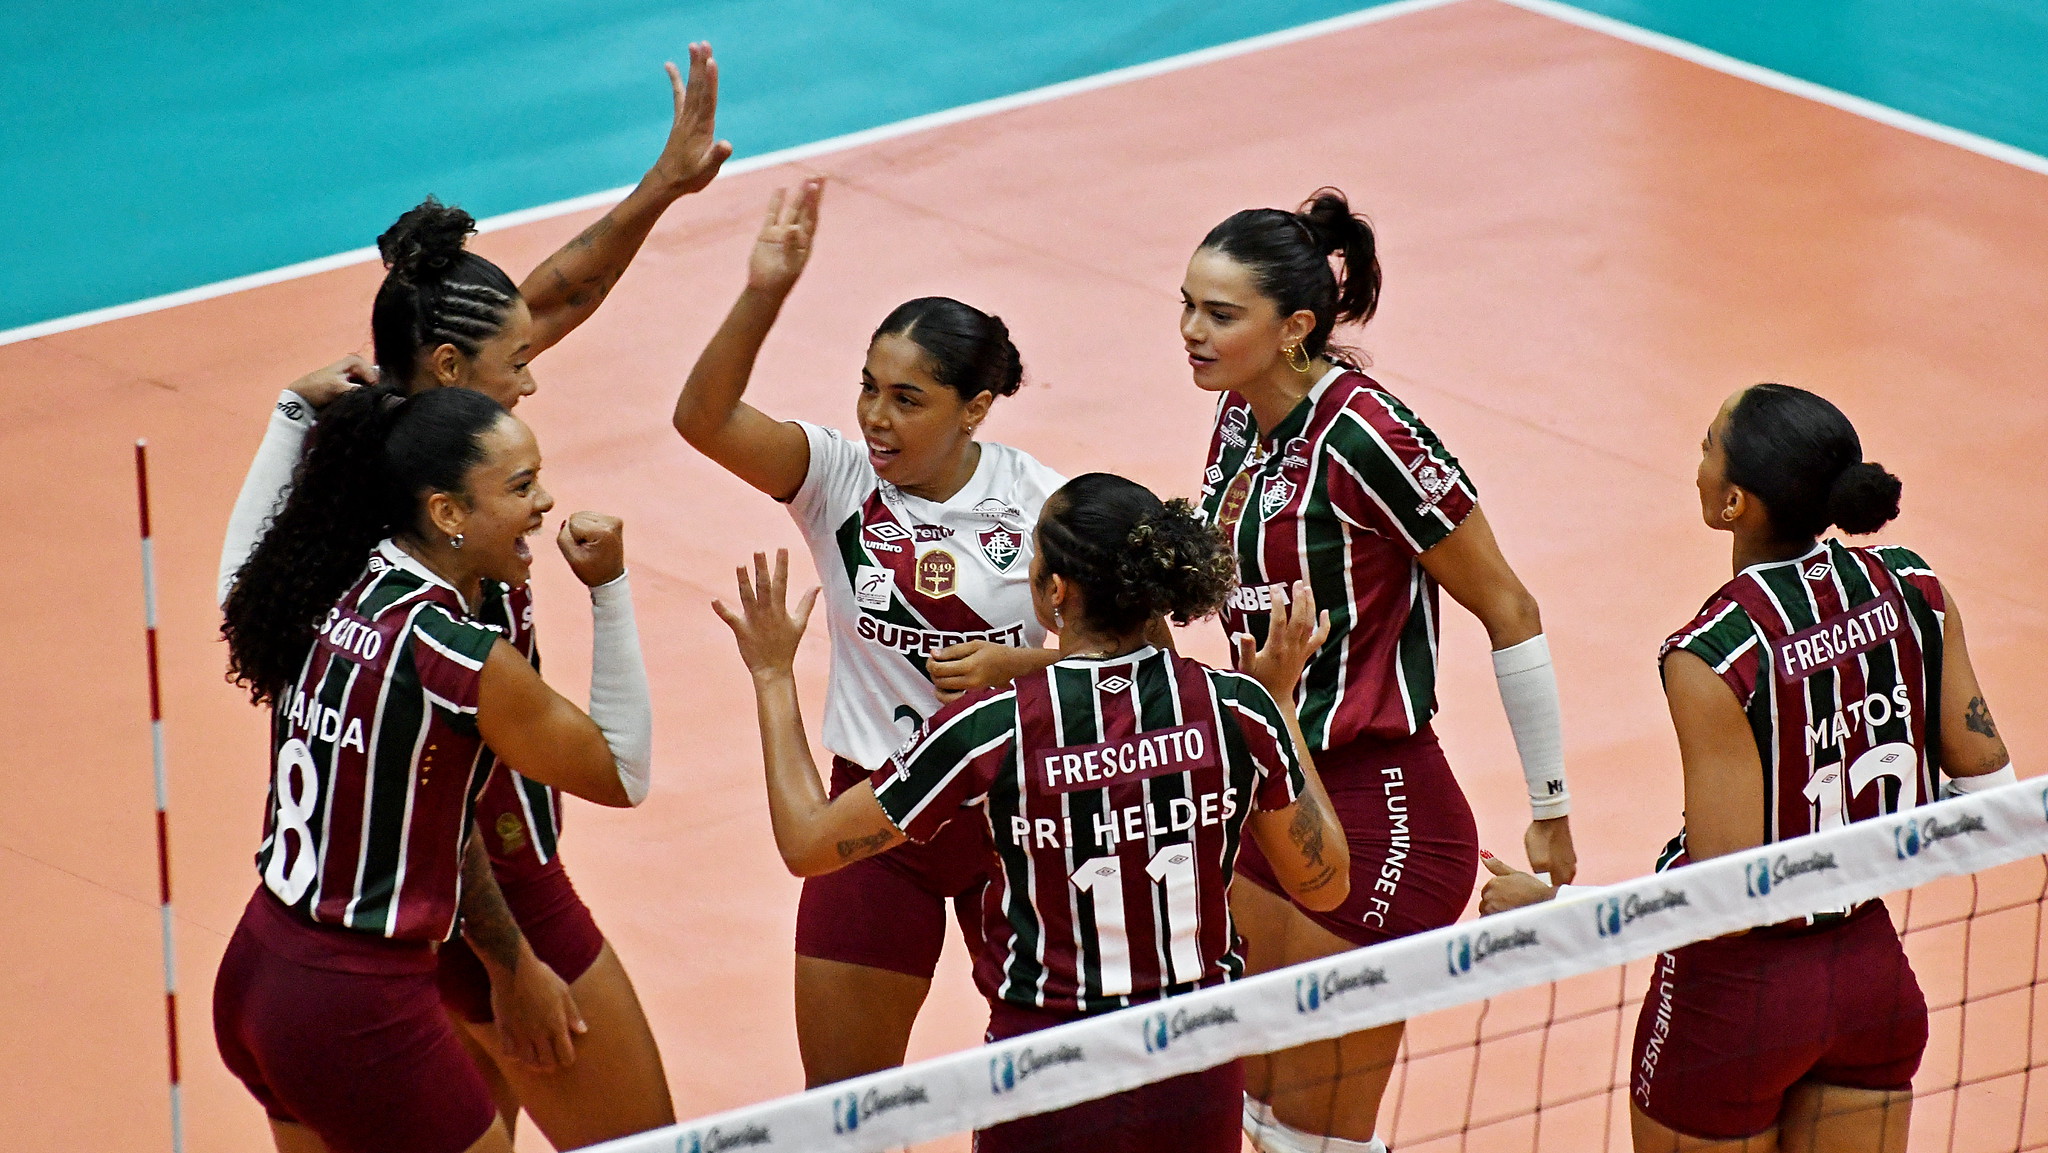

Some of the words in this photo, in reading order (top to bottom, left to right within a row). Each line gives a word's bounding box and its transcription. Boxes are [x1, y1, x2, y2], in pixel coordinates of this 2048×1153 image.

[865, 540, 902, 554] umbro
[923, 562, 952, 573] 1949
[1782, 600, 1899, 676] FRESCATTO
[1804, 683, 1911, 756] MATOS
[1045, 728, 1205, 787] FRESCATTO
[264, 738, 319, 907] 8
[1011, 815, 1073, 849] PRI
[1093, 787, 1238, 847] HELDES
[1069, 842, 1205, 997] 11
[1362, 897, 1390, 928] FC
